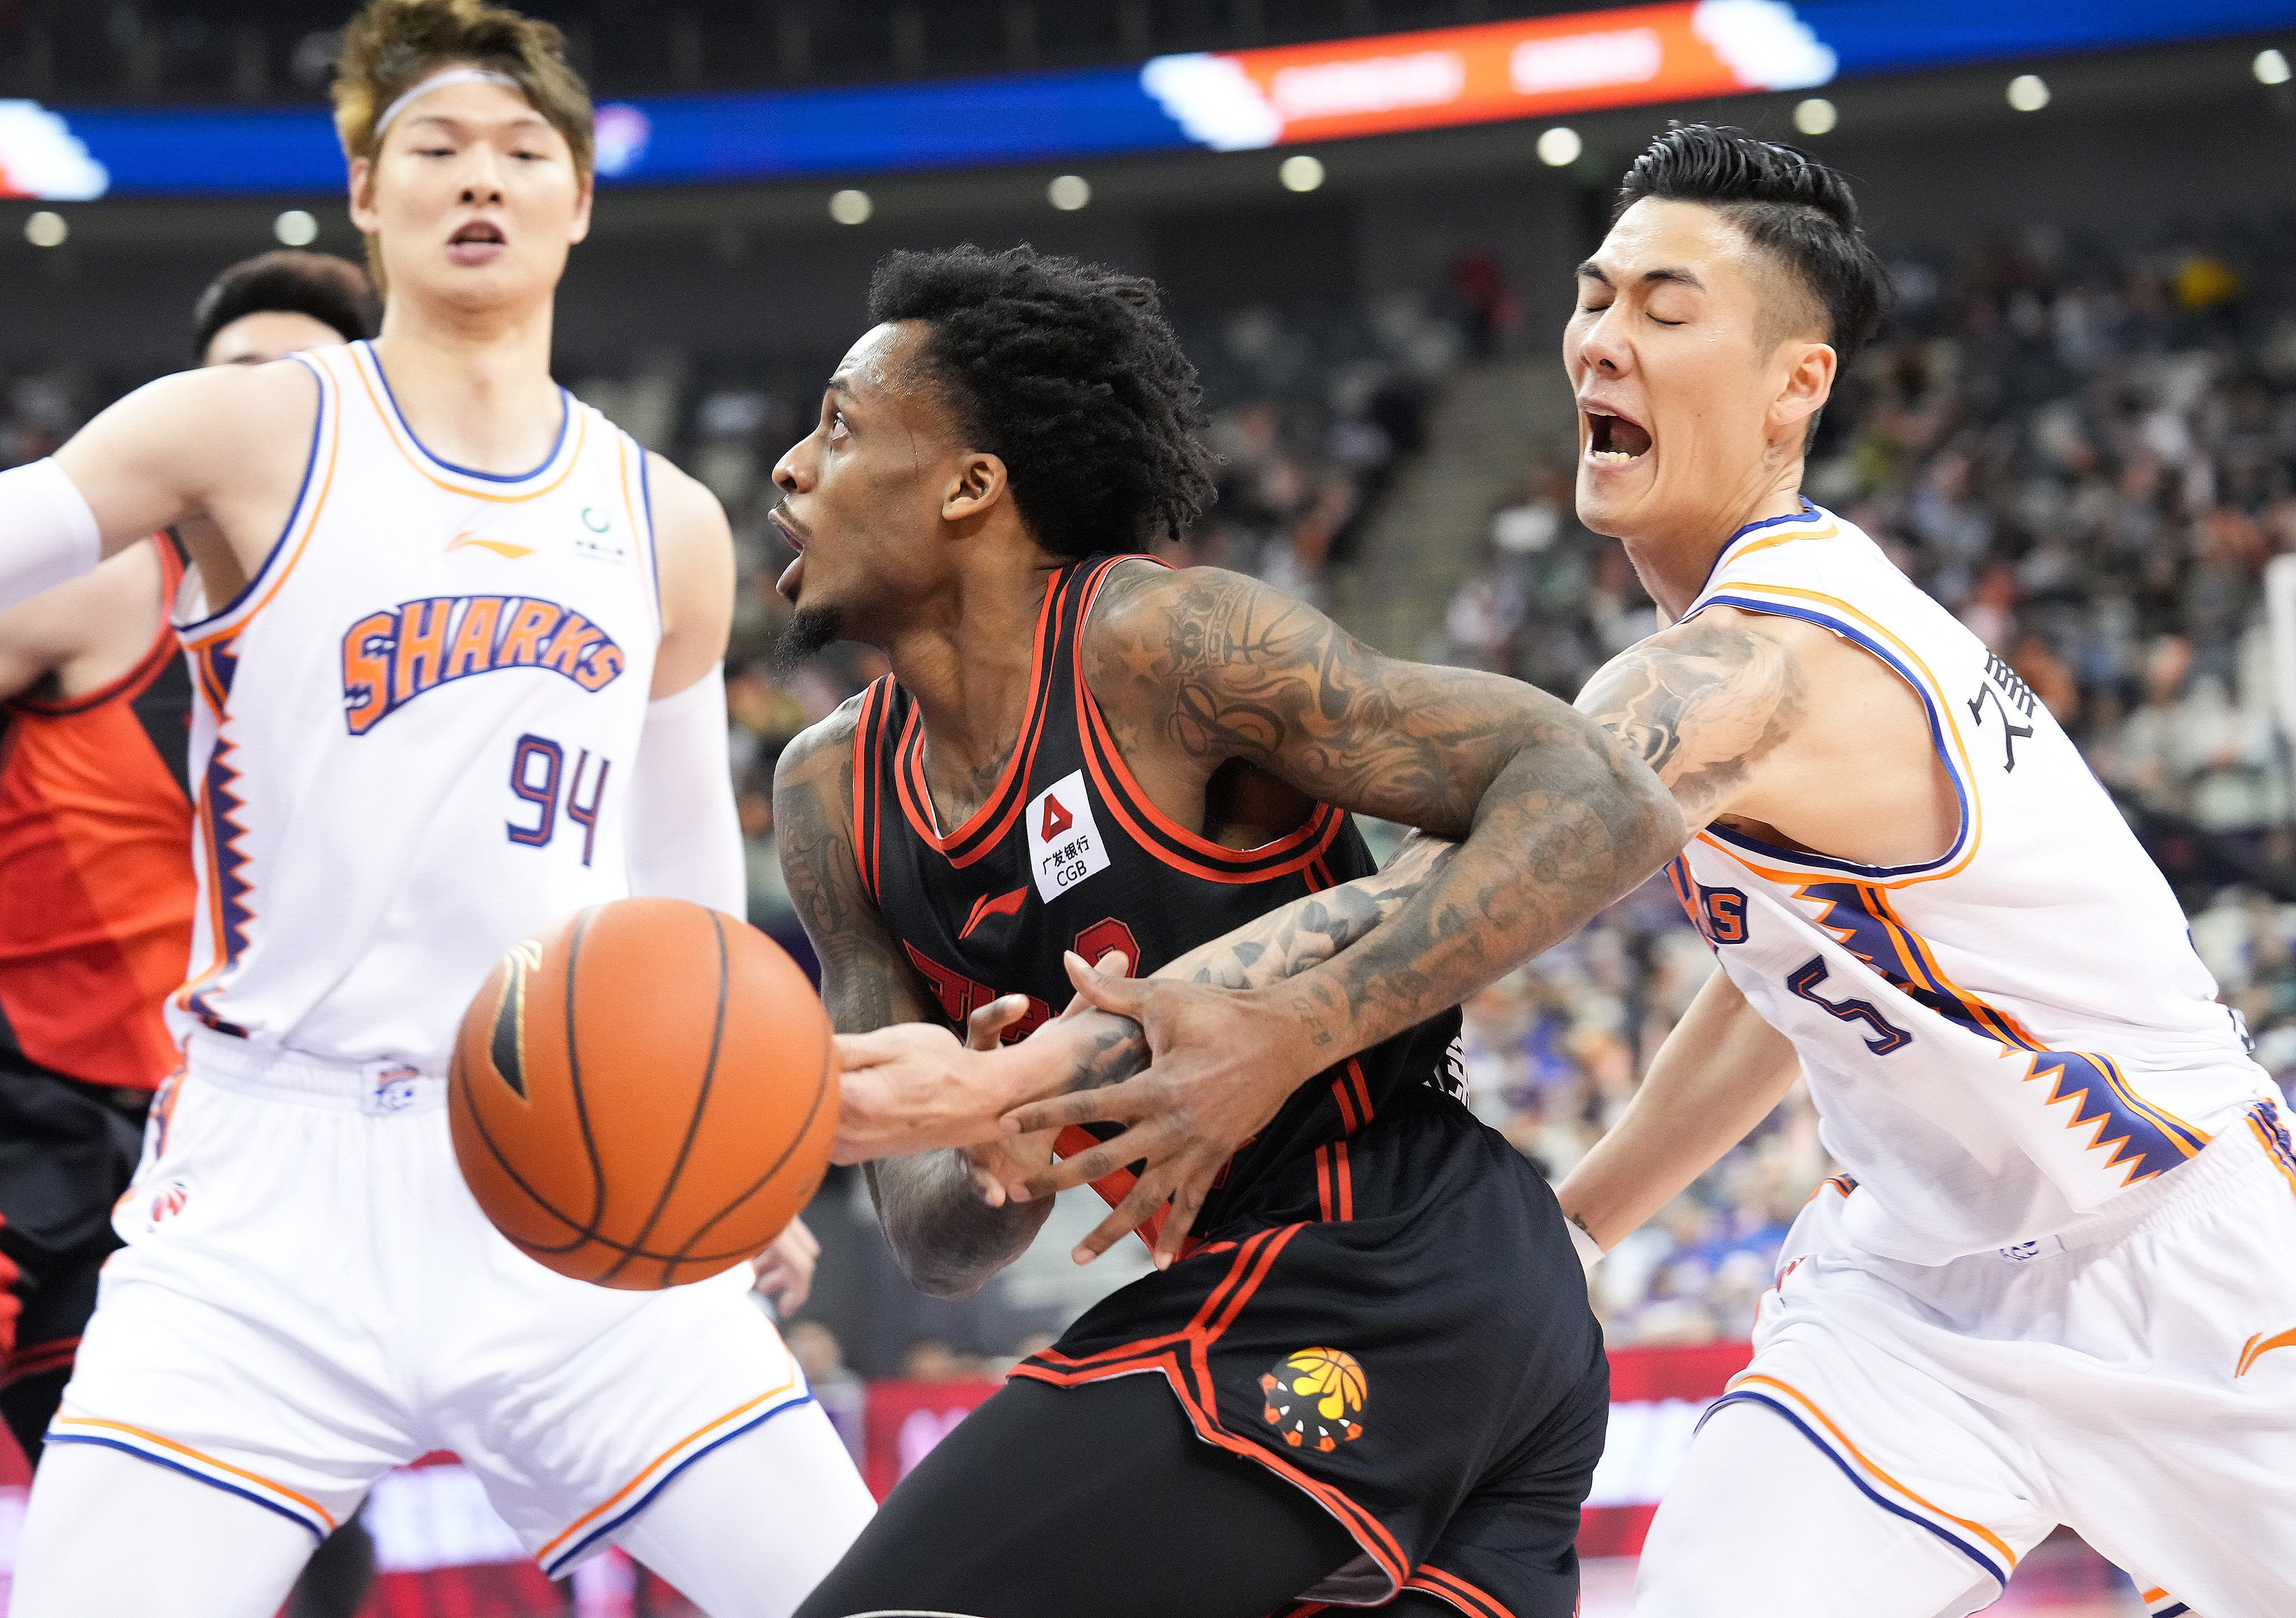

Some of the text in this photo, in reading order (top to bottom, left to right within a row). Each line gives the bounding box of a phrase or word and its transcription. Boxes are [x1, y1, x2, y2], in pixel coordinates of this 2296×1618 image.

[341, 594, 625, 736] SHARKS
[505, 733, 610, 868] 94
[1042, 834, 1090, 875] 广发银行
[1057, 860, 1087, 887] CGB
[1786, 954, 1913, 1056] 5
